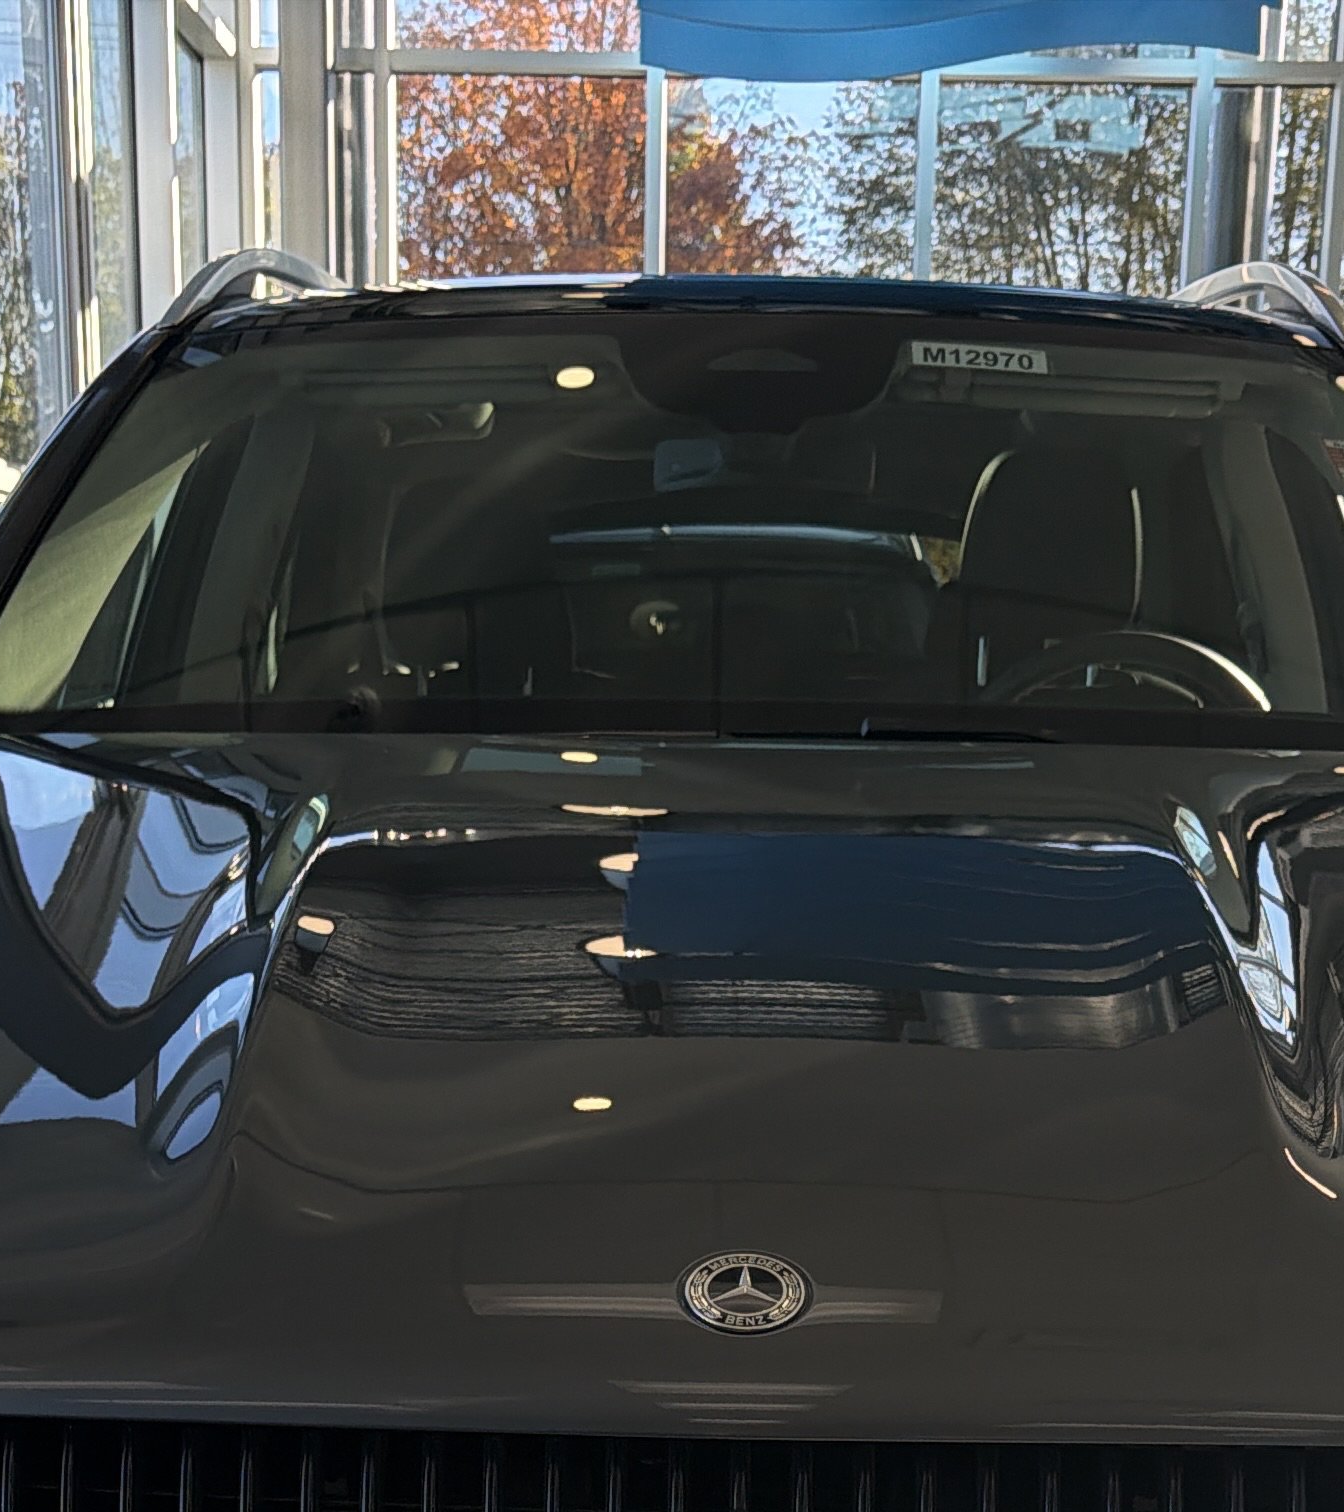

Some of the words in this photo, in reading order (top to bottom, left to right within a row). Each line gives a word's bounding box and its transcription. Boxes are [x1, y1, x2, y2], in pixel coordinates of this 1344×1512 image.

[922, 347, 1034, 370] M12970
[709, 1256, 784, 1272] MERCEDES
[725, 1314, 767, 1326] BENZ
